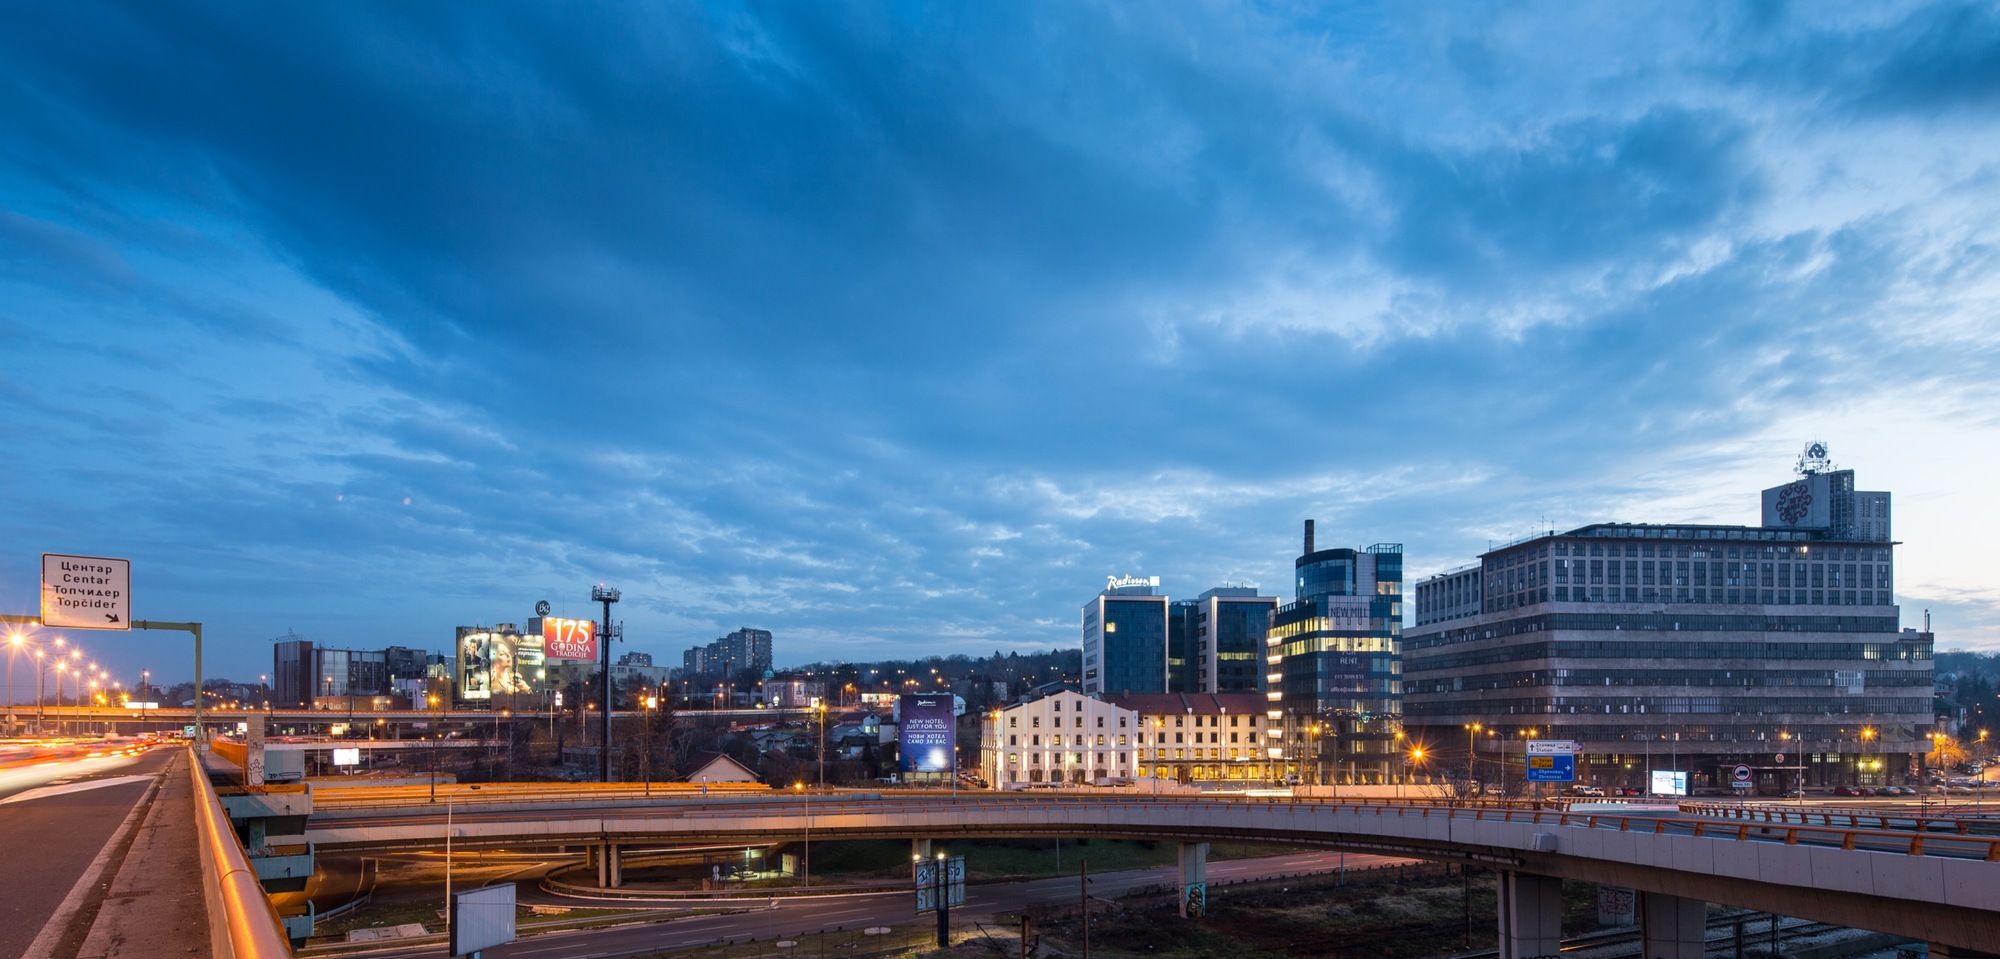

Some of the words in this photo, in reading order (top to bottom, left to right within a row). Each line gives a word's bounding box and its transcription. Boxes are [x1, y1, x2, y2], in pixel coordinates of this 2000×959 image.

[61, 561, 113, 575] Центар
[63, 573, 111, 585] Centar
[1107, 573, 1150, 591] Radisson
[53, 584, 120, 599] Топчидер
[57, 596, 117, 609] Topčider
[1330, 607, 1349, 617] NEW
[1351, 607, 1368, 617] MILL
[554, 619, 589, 644] 175
[550, 642, 591, 653] GODINA
[1340, 657, 1358, 665] RENT
